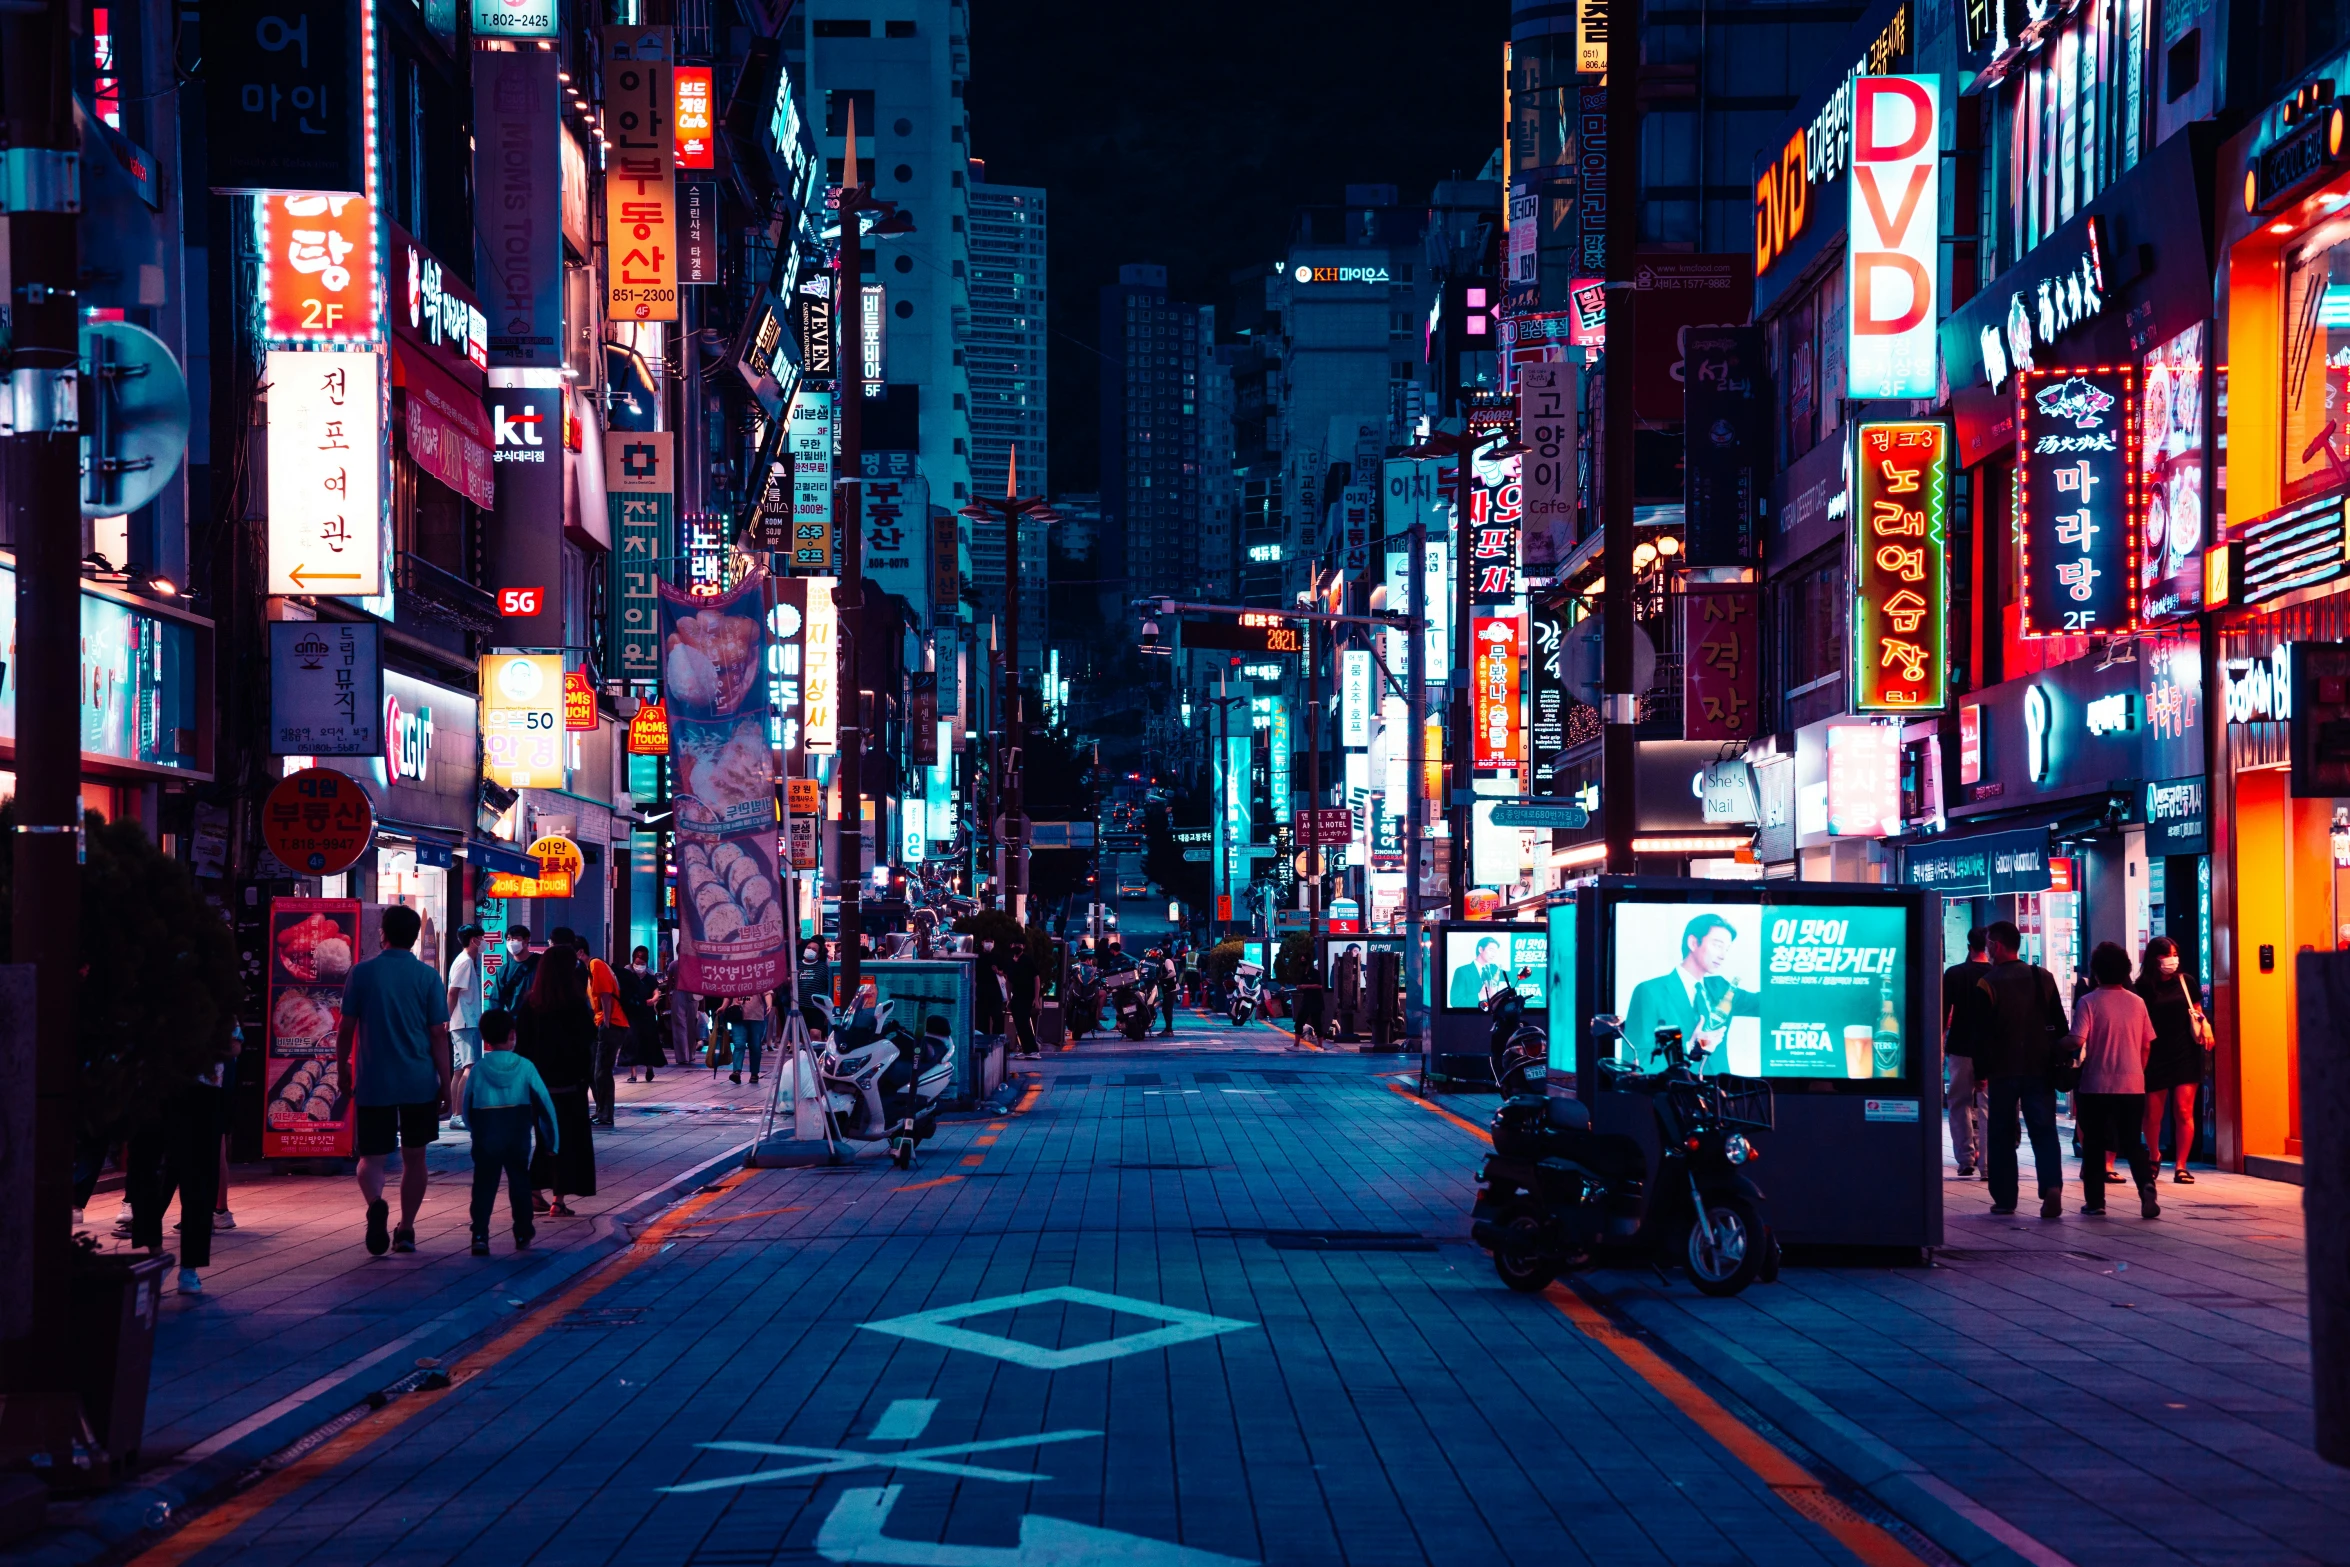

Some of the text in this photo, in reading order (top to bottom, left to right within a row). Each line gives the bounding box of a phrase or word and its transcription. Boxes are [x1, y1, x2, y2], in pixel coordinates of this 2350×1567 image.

[481, 13, 549, 28] T.802-2425
[256, 13, 308, 69] 어
[1583, 50, 1599, 59] 051)
[678, 82, 707, 96] 보드
[242, 82, 327, 134] 마인
[678, 98, 707, 113] 게임
[679, 113, 708, 128] Cafe
[619, 67, 665, 286] 이안부동산
[1756, 126, 1808, 278] DVD
[1852, 76, 1934, 337] DVD
[689, 185, 702, 281] 스크린사격 타겟존
[504, 218, 533, 312] TOUCH
[1679, 263, 1731, 273] kmcfood.com
[1654, 278, 1682, 290] 서비스
[1682, 278, 1731, 289] 1577-9882
[612, 289, 675, 302] 851-2300
[300, 298, 344, 330] 2F
[635, 305, 650, 317] 4F
[811, 301, 830, 373] 7EVEN
[863, 295, 882, 379] 비트포비아
[1519, 317, 1569, 340] 감성주점
[865, 384, 881, 397] 5F
[1879, 380, 1906, 398] 3F
[494, 404, 545, 446] kt
[800, 439, 821, 450] 무한
[1533, 392, 1566, 494] 고양이
[317, 367, 351, 554] 전포여관
[493, 450, 545, 463] 공식대리점
[861, 453, 910, 476] 명문
[802, 493, 818, 503] 메뉴
[1345, 491, 1369, 505] 이지
[1390, 474, 1431, 505] 이지
[1529, 499, 1571, 514] Cafe
[764, 517, 783, 526] ROOM
[866, 482, 905, 551] 부동산
[765, 527, 782, 536] SOJU
[796, 525, 823, 540] 소주
[1347, 507, 1365, 569] 부동산
[2053, 459, 2101, 601] 마라탕
[766, 537, 780, 546] HOF
[797, 549, 824, 563] 호프
[937, 530, 957, 595] 부동산
[1475, 529, 1511, 593] 포차
[1873, 459, 1929, 682] 노래연습장
[504, 591, 535, 613] 5G
[2062, 610, 2096, 631] 2F
[1350, 663, 1363, 676] 룸
[1701, 595, 1749, 730] 사격장
[805, 622, 829, 728] 지구상사
[1350, 680, 1363, 705] 소주
[1885, 690, 1918, 703] B1
[2146, 679, 2183, 741] 마라탕
[1350, 708, 1363, 732] 호프
[633, 733, 669, 746] TOUCH
[486, 733, 557, 770] 안경
[792, 784, 811, 794] 장원
[1708, 773, 1745, 788] She's
[1708, 798, 1734, 813] Nail
[271, 802, 367, 833] 부동산
[1325, 820, 1347, 829] HOTEL
[1495, 812, 1505, 820] 25
[279, 837, 355, 850] T.818-9947
[538, 841, 567, 854] 이안
[907, 833, 921, 857] CU
[309, 855, 326, 866] 4F
[537, 877, 568, 892] TOUCH
[1771, 919, 1850, 946] 이 맛이
[1514, 938, 1526, 950] 이
[1769, 945, 1897, 974] 청정라거다!
[1515, 987, 1543, 997] TERRA
[1770, 1029, 1834, 1053] TERRA
[280, 1135, 335, 1146] 떡장인방앗간
